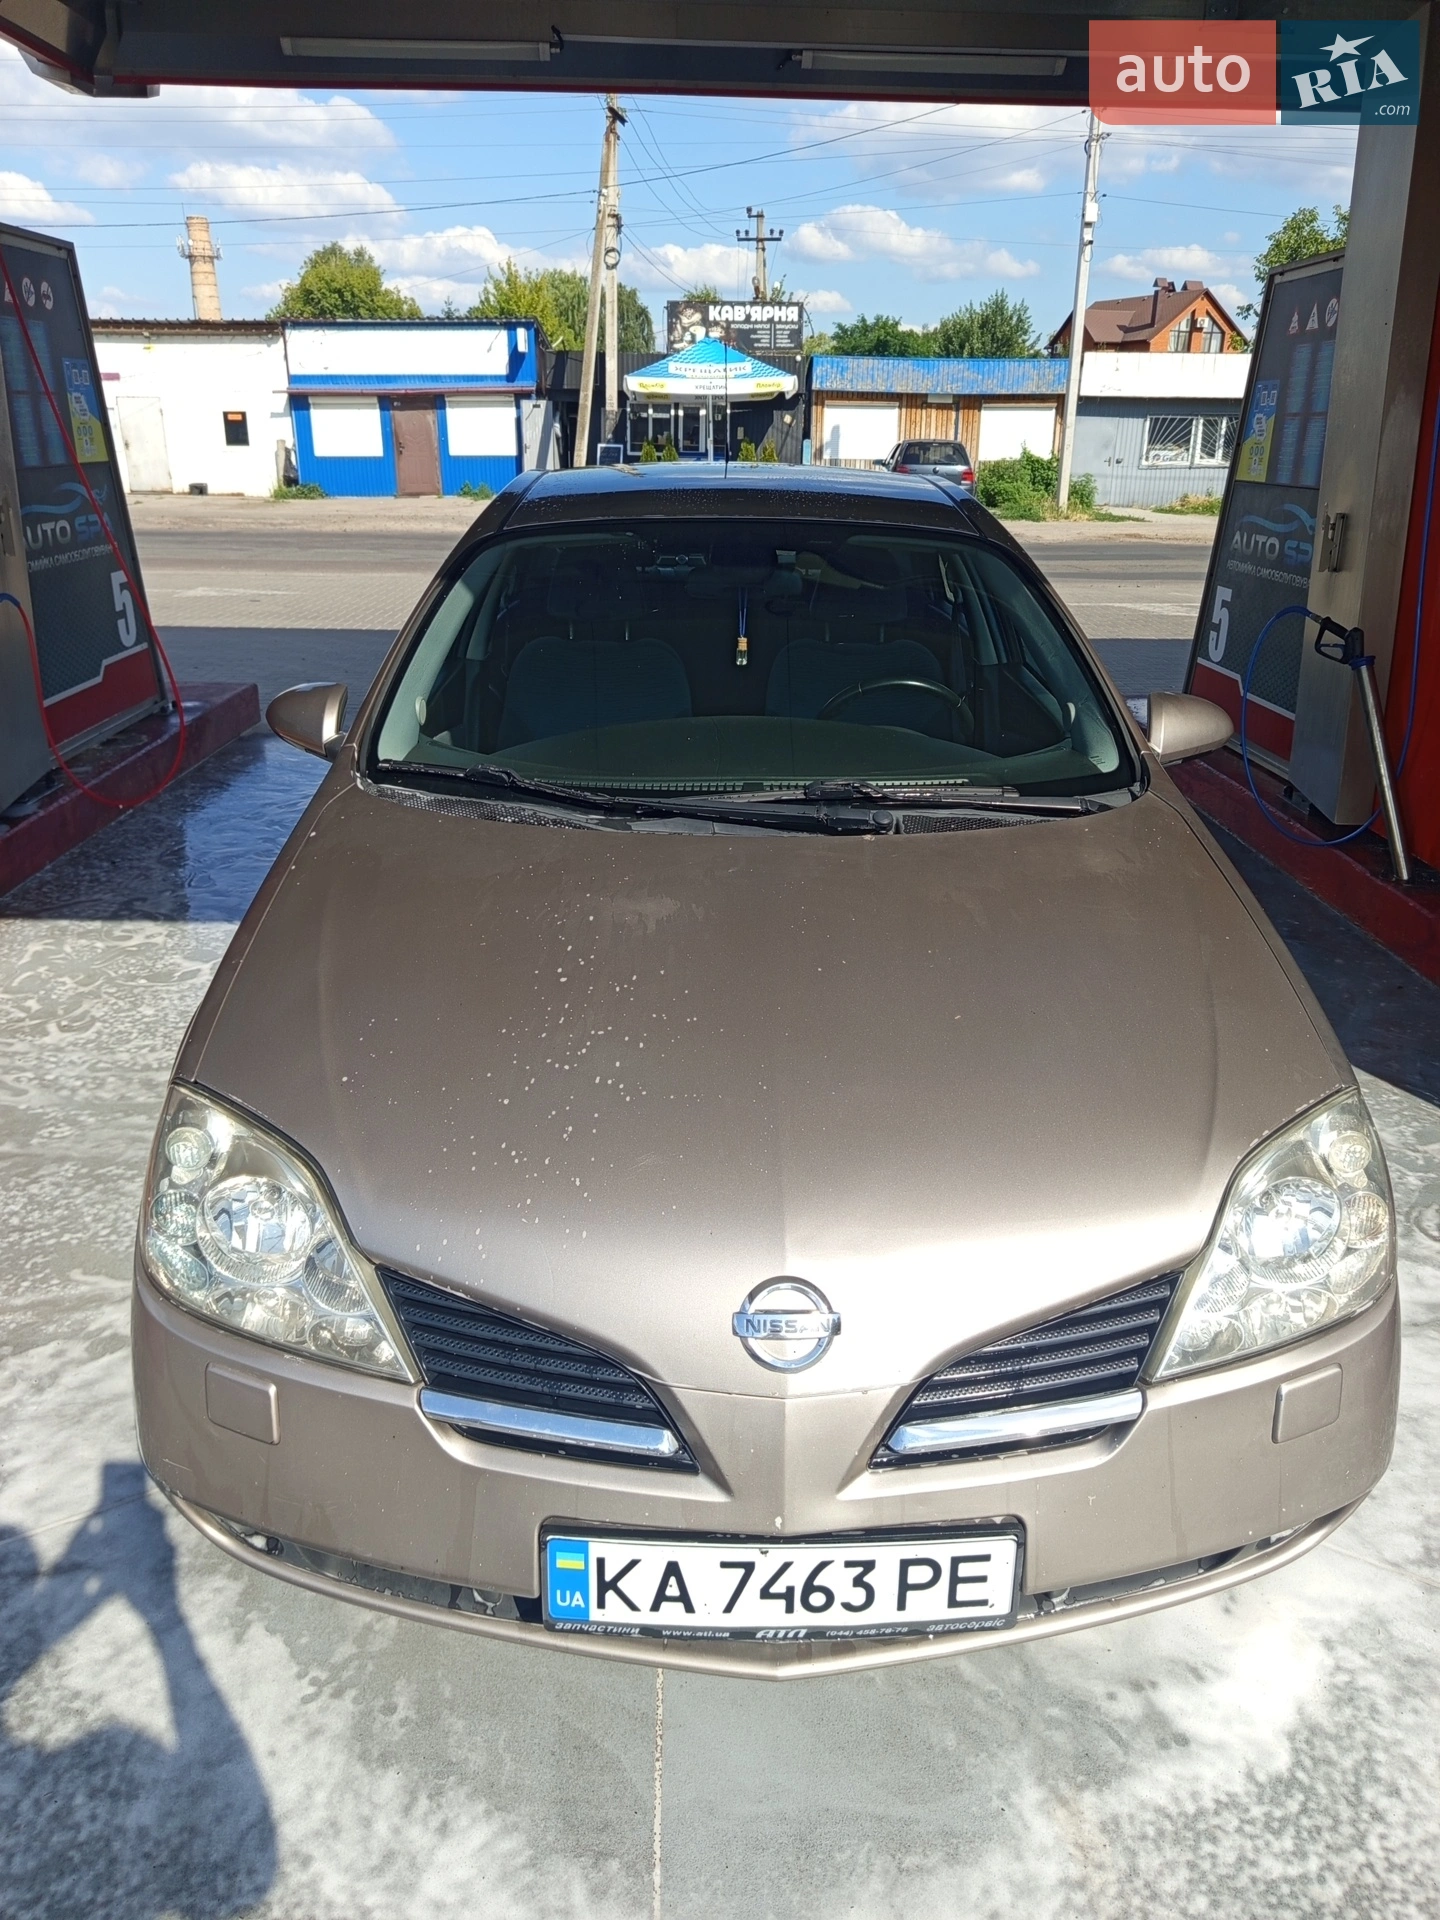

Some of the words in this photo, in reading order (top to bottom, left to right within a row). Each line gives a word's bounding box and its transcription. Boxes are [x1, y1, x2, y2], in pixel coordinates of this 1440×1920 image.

[708, 305, 799, 322] КАВ'ЯРНЯ
[23, 519, 71, 550] UTO
[1230, 530, 1280, 561] AUTO
[1284, 539, 1313, 567] SP
[27, 555, 55, 573] ОМИЙКА
[110, 570, 137, 648] 5
[1208, 585, 1232, 663] 5
[595, 1556, 696, 1615] KA
[719, 1558, 876, 1615] 7463
[895, 1553, 993, 1611] PE
[556, 1590, 585, 1608] UA
[661, 1629, 730, 1638] www.atl.ua
[825, 1628, 854, 1637] (044)
